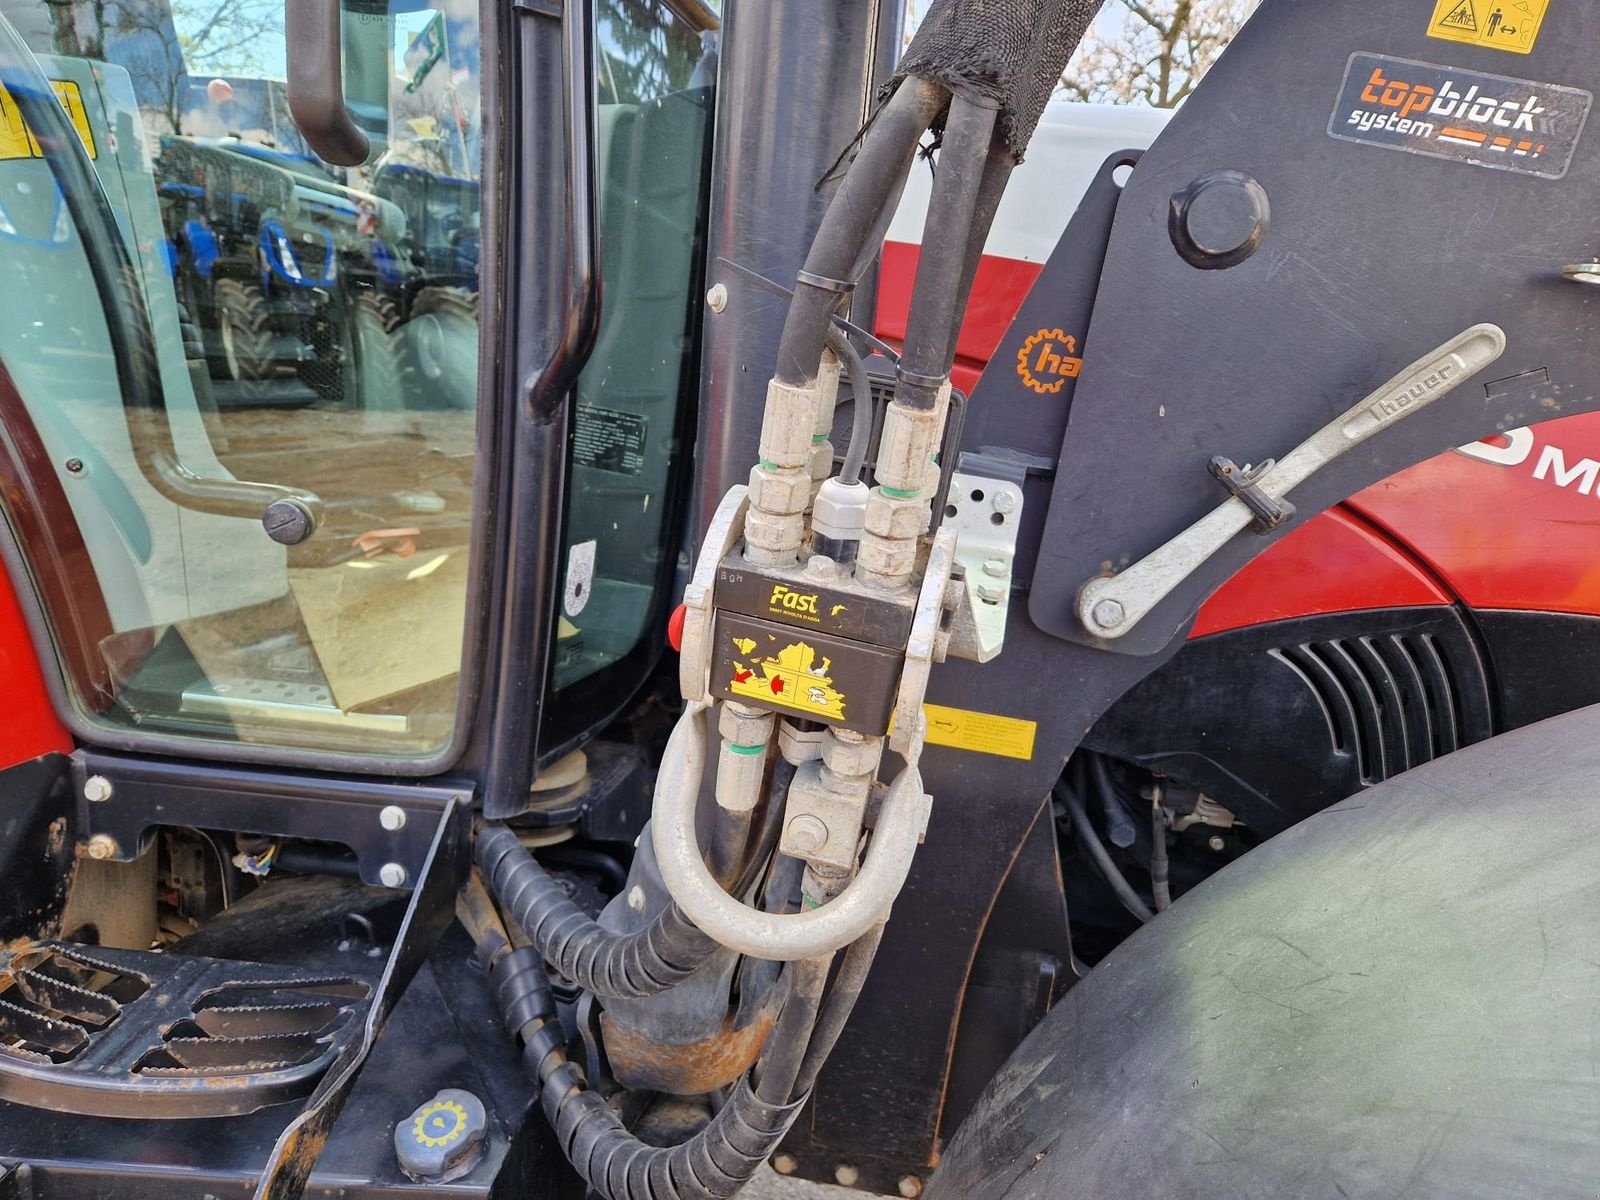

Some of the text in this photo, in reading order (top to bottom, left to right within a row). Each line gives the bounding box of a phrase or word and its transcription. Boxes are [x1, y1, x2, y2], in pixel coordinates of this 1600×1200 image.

[1347, 109, 1434, 138] system
[1360, 67, 1544, 131] topblock
[1379, 364, 1452, 416] hauer
[1532, 444, 1600, 500] M
[770, 585, 818, 614] Fast
